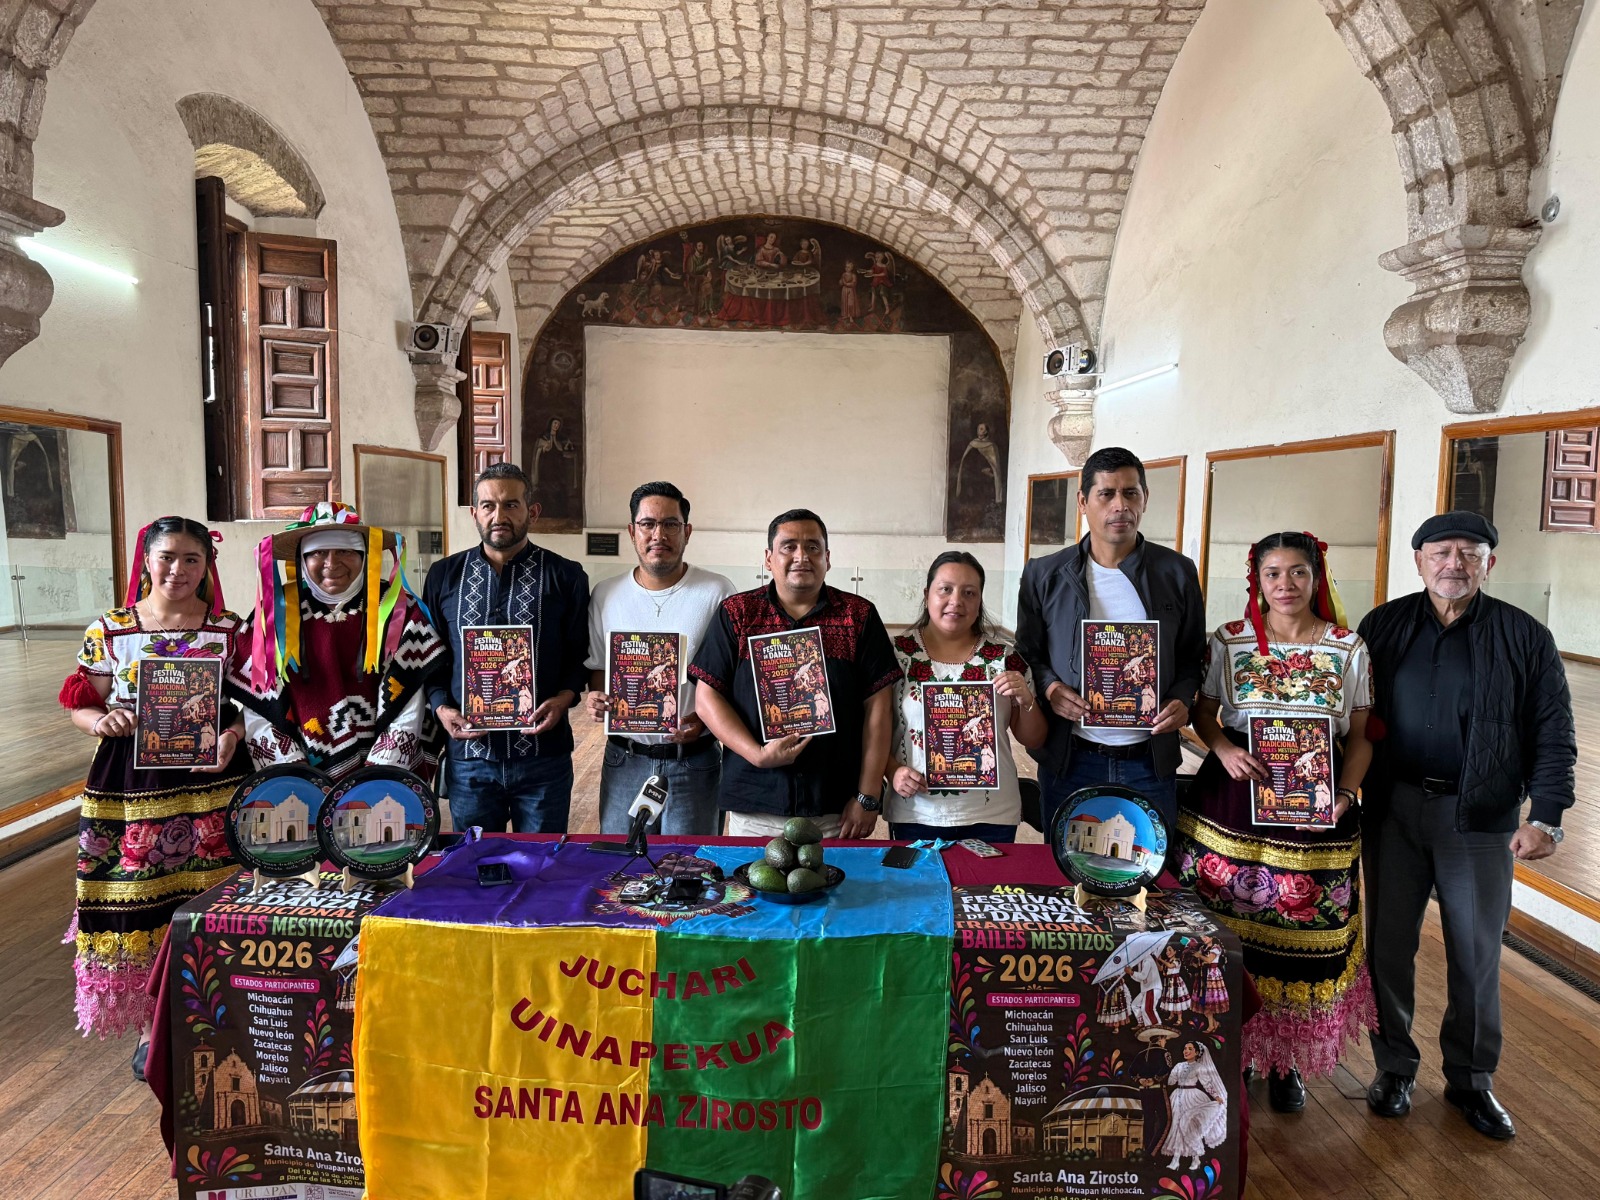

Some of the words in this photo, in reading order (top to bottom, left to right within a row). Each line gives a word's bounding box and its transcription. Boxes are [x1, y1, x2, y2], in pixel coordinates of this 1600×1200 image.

[474, 637, 502, 645] FESTIVAL
[1095, 632, 1125, 640] FESTIVAL
[621, 641, 649, 649] FESTIVAL
[763, 644, 791, 654] FESTIVAL
[769, 651, 792, 659] DANZA
[760, 657, 795, 666] TRADICIONAL
[153, 670, 185, 678] FESTIVAL
[772, 669, 789, 677] 2026
[934, 693, 963, 702] FESTIVAL
[1263, 727, 1295, 735] FESTIVAL
[1269, 734, 1296, 742] DANZA
[235, 896, 261, 904] DE
[259, 895, 359, 910] DANZA
[960, 894, 1078, 906] FESTIVAL
[205, 903, 357, 918] TRADICIONAL
[962, 903, 1092, 916] NACIONAL
[990, 911, 1093, 925] DANZA
[189, 912, 202, 932] Y
[205, 913, 268, 935] BAILES
[272, 916, 354, 939] MESTIZOS
[955, 920, 1109, 934] TRADICIONAL
[962, 930, 1026, 950] BAILES
[1031, 931, 1115, 951] MESTIZOS
[240, 939, 313, 968] 2026
[1000, 954, 1074, 982] 2026
[559, 954, 758, 1000] JUCHARI
[235, 978, 262, 988] ESTADOS
[264, 981, 314, 990] PARTICIPANTES
[247, 992, 293, 1004] Michoacán
[992, 996, 1022, 1004] ESTADOS
[1024, 996, 1075, 1004] PARTICIPANTES
[248, 1004, 293, 1016] Chihuahua
[1004, 1010, 1054, 1019] Michoacán
[253, 1016, 269, 1026] San
[270, 1018, 288, 1028] Luis
[1005, 1022, 1053, 1032] Chihuahua
[248, 1027, 274, 1037] Nuevo
[276, 1030, 294, 1040] león
[510, 997, 795, 1071] UINAPEKUA
[1010, 1034, 1027, 1043] San
[1029, 1035, 1048, 1044] Luis
[253, 1039, 292, 1052] Zacatecas
[256, 1050, 289, 1062] Morelos
[1004, 1047, 1033, 1056] Nuevo
[1035, 1047, 1054, 1056] león
[260, 1063, 288, 1073] Jalisco
[1008, 1060, 1051, 1069] Zacatecas
[259, 1074, 291, 1084] Nayarit
[1011, 1072, 1047, 1081] Morelos
[1015, 1084, 1046, 1093] Jalisco
[1014, 1096, 1047, 1106] Nayarit
[474, 1085, 584, 1125] SANTA
[594, 1092, 666, 1128] ANA
[676, 1095, 823, 1132] ZIROSTO
[264, 1143, 303, 1158] Santa
[307, 1148, 332, 1162] Ana
[264, 1159, 302, 1167] Municipio
[315, 1162, 346, 1172] Uruapan
[287, 1174, 307, 1182] partir
[1013, 1171, 1053, 1183] Santa
[1057, 1169, 1085, 1184] Ana
[1089, 1171, 1138, 1184] Zirosto
[234, 1185, 297, 1200] URUAPAN
[1011, 1186, 1051, 1194] Municipio
[1066, 1186, 1100, 1195] Uruapan
[1101, 1187, 1145, 1195] Michoacán.
